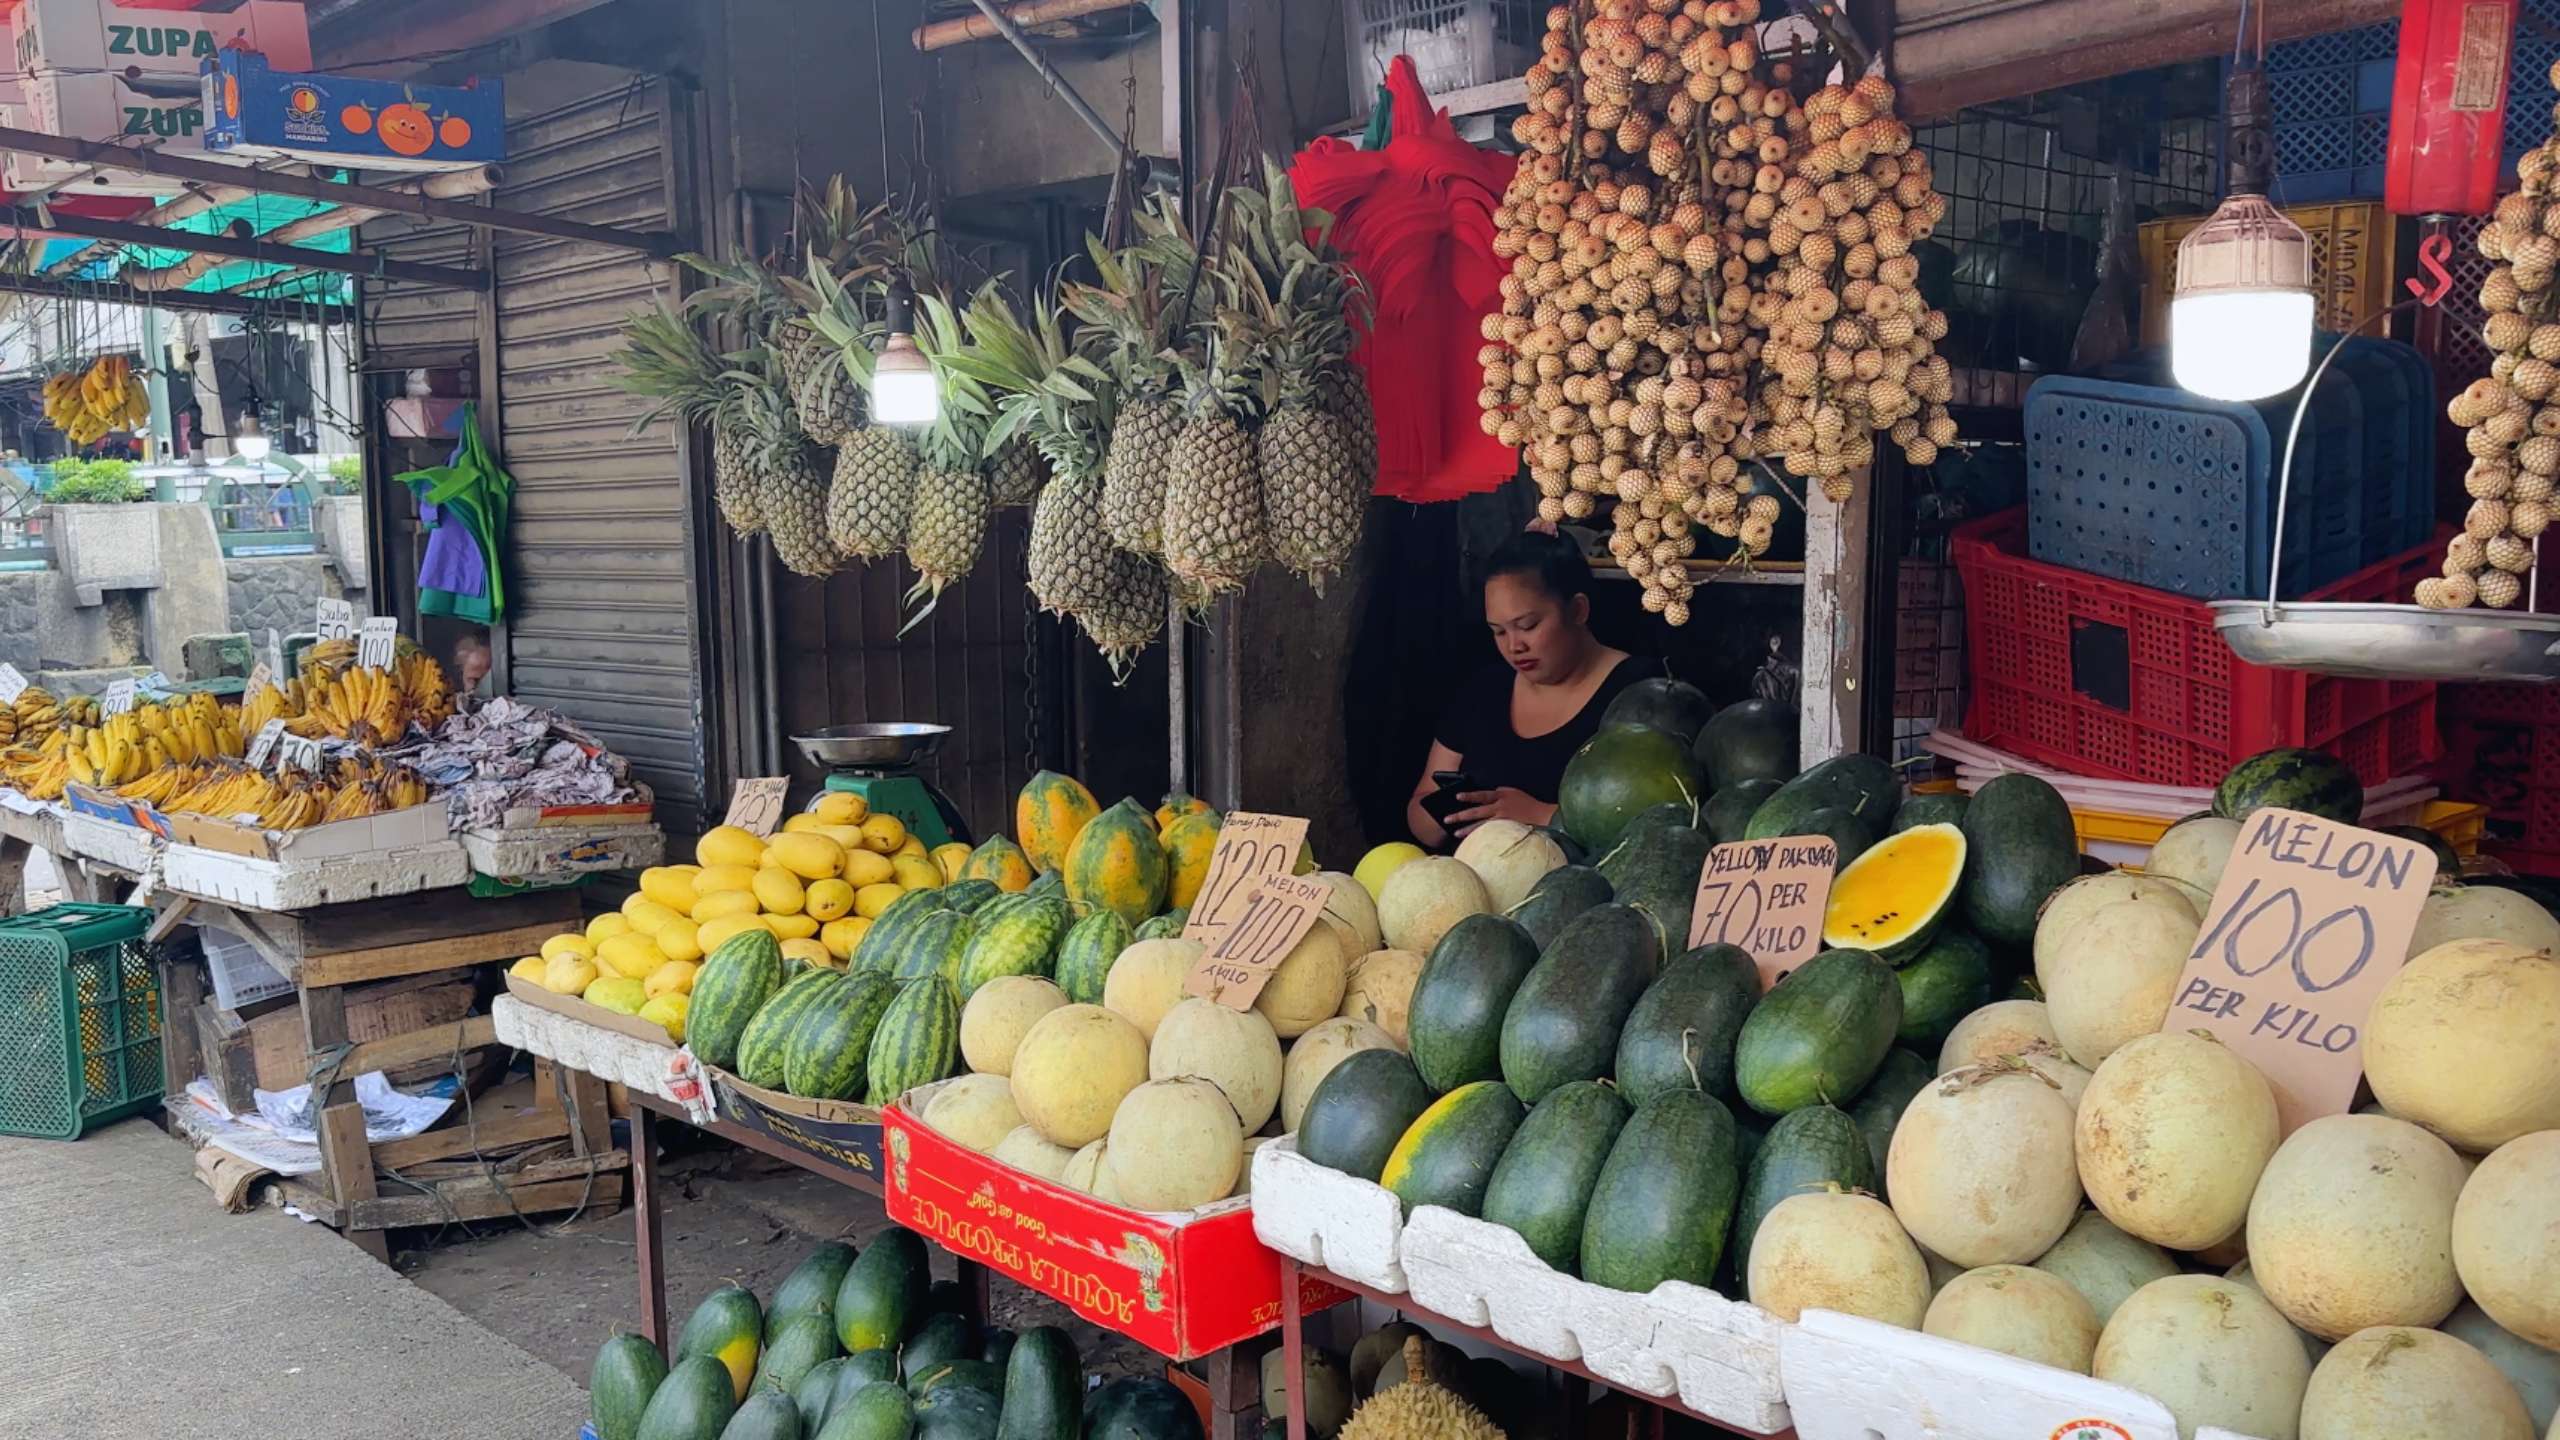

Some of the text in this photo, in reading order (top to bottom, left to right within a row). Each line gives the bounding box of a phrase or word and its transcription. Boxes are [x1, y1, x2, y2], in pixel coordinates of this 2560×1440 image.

[108, 25, 219, 59] ZUPA
[362, 638, 390, 668] 100
[2244, 814, 2415, 890] MELON
[1264, 873, 1323, 901] MELON
[1699, 878, 1762, 947] 70
[1766, 883, 1808, 911] PER
[1212, 894, 1305, 965] 100
[1752, 925, 1806, 954] KILO
[2189, 878, 2375, 992] 100
[2174, 976, 2357, 1053] PER KILO
[909, 1194, 1137, 1324] AQUILA PRODUCE
